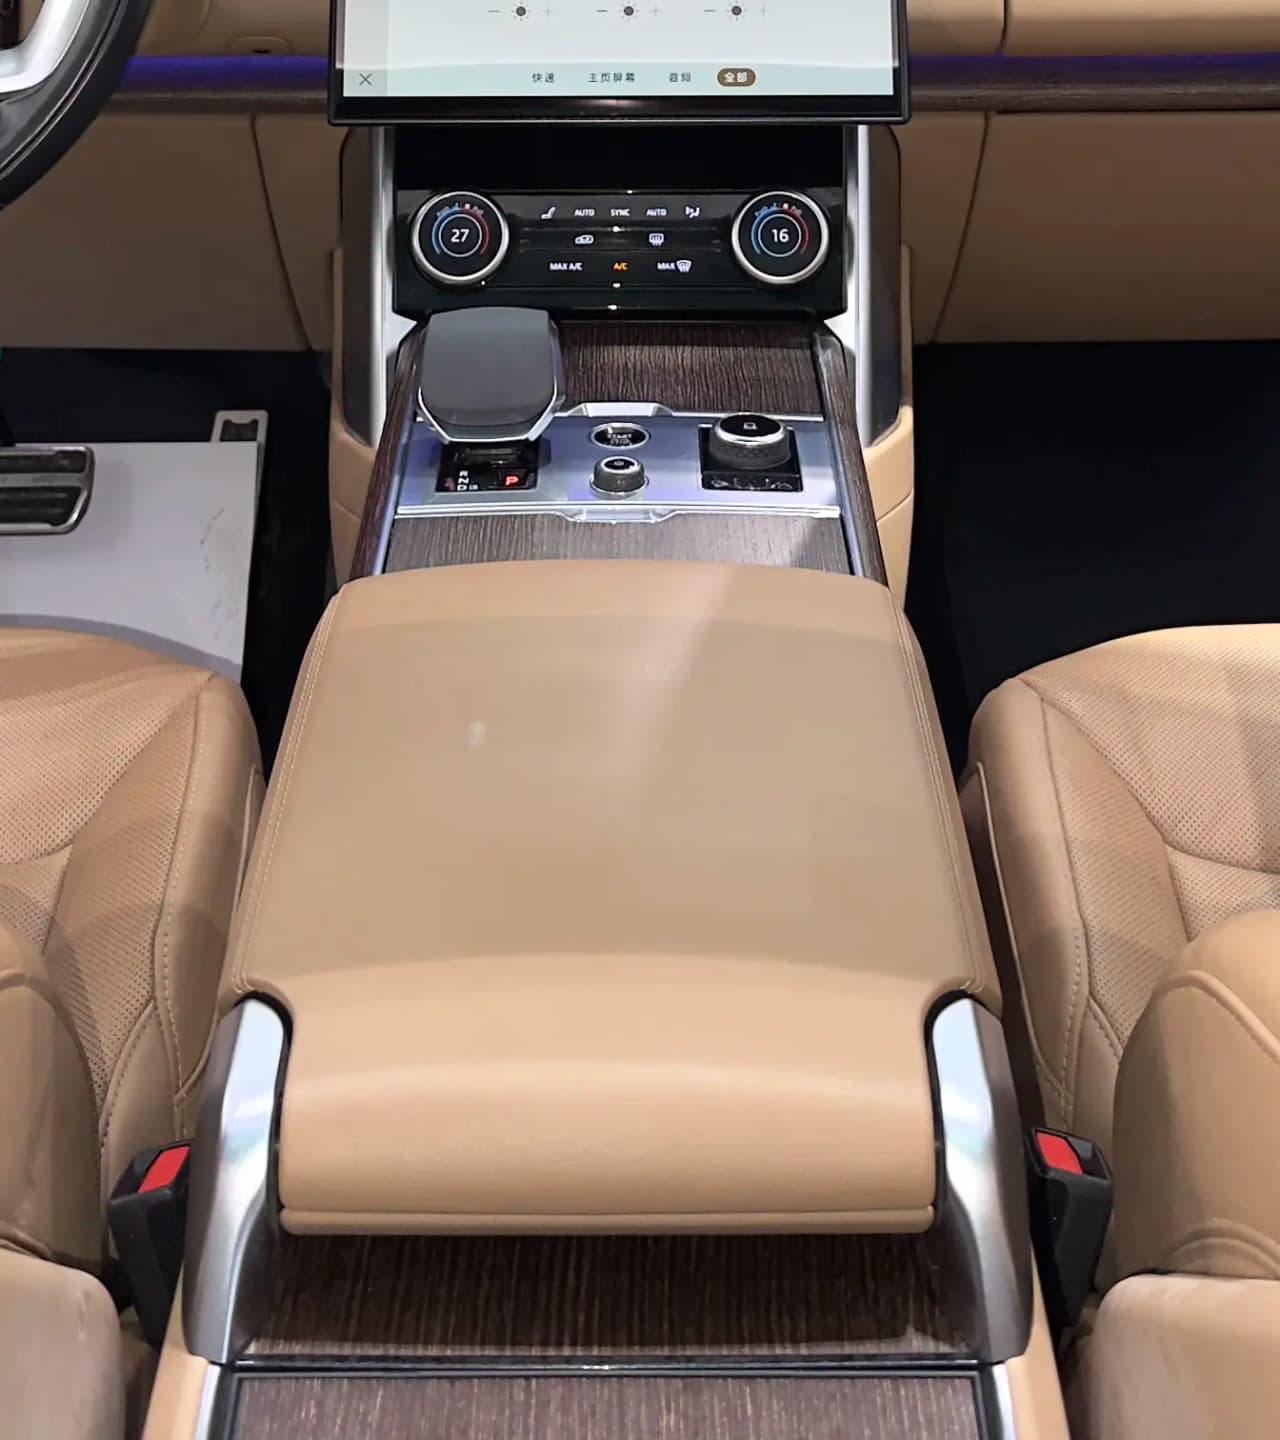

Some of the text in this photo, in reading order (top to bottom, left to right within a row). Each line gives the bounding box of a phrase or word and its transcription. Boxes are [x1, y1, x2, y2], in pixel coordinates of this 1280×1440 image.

[532, 72, 555, 84] 快速
[574, 208, 596, 217] AUTO
[610, 208, 631, 217] SYNC
[646, 208, 667, 217] AUTO
[451, 228, 470, 243] 27
[772, 228, 790, 243] 16
[549, 262, 583, 271] MAX A/C
[613, 262, 629, 271] A/C
[657, 262, 676, 271] MAX
[505, 475, 519, 486] P
